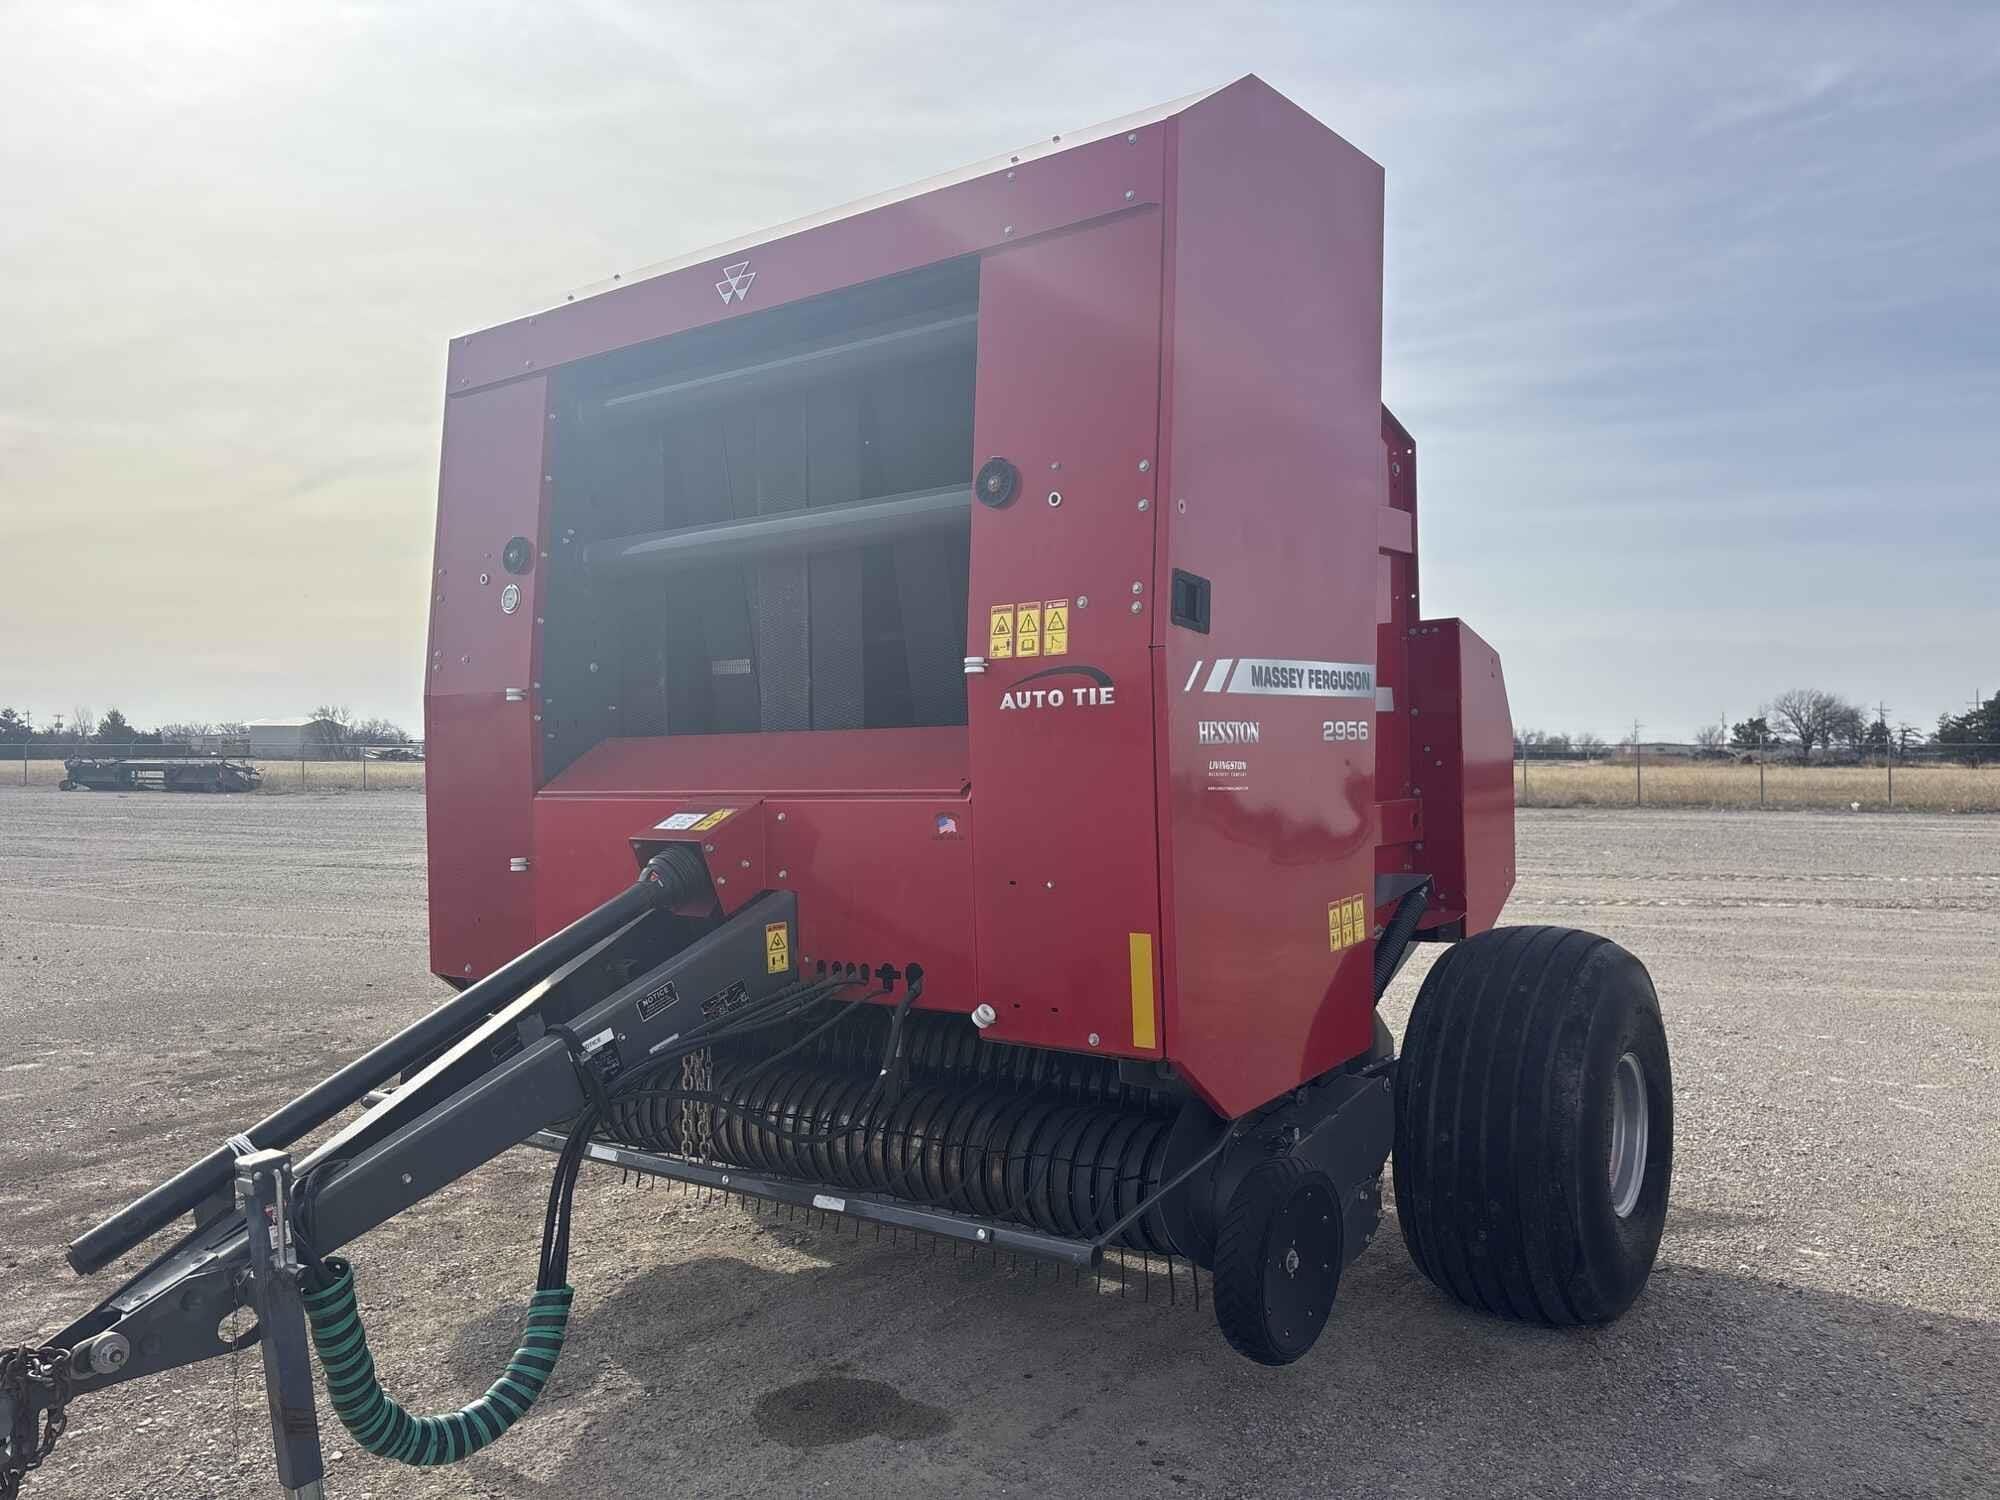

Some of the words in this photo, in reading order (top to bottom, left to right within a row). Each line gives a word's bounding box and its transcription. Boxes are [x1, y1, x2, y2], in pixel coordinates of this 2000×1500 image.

[1251, 664, 1304, 689] MASSEY
[1308, 669, 1370, 691] FERGUSON
[1000, 689, 1065, 710] AUTO
[1072, 687, 1115, 705] TIE
[1198, 721, 1260, 744] HESSTON
[1322, 721, 1369, 741] 2956
[1208, 760, 1247, 770] LIVINGSTON
[642, 986, 669, 1006] NOTICE
